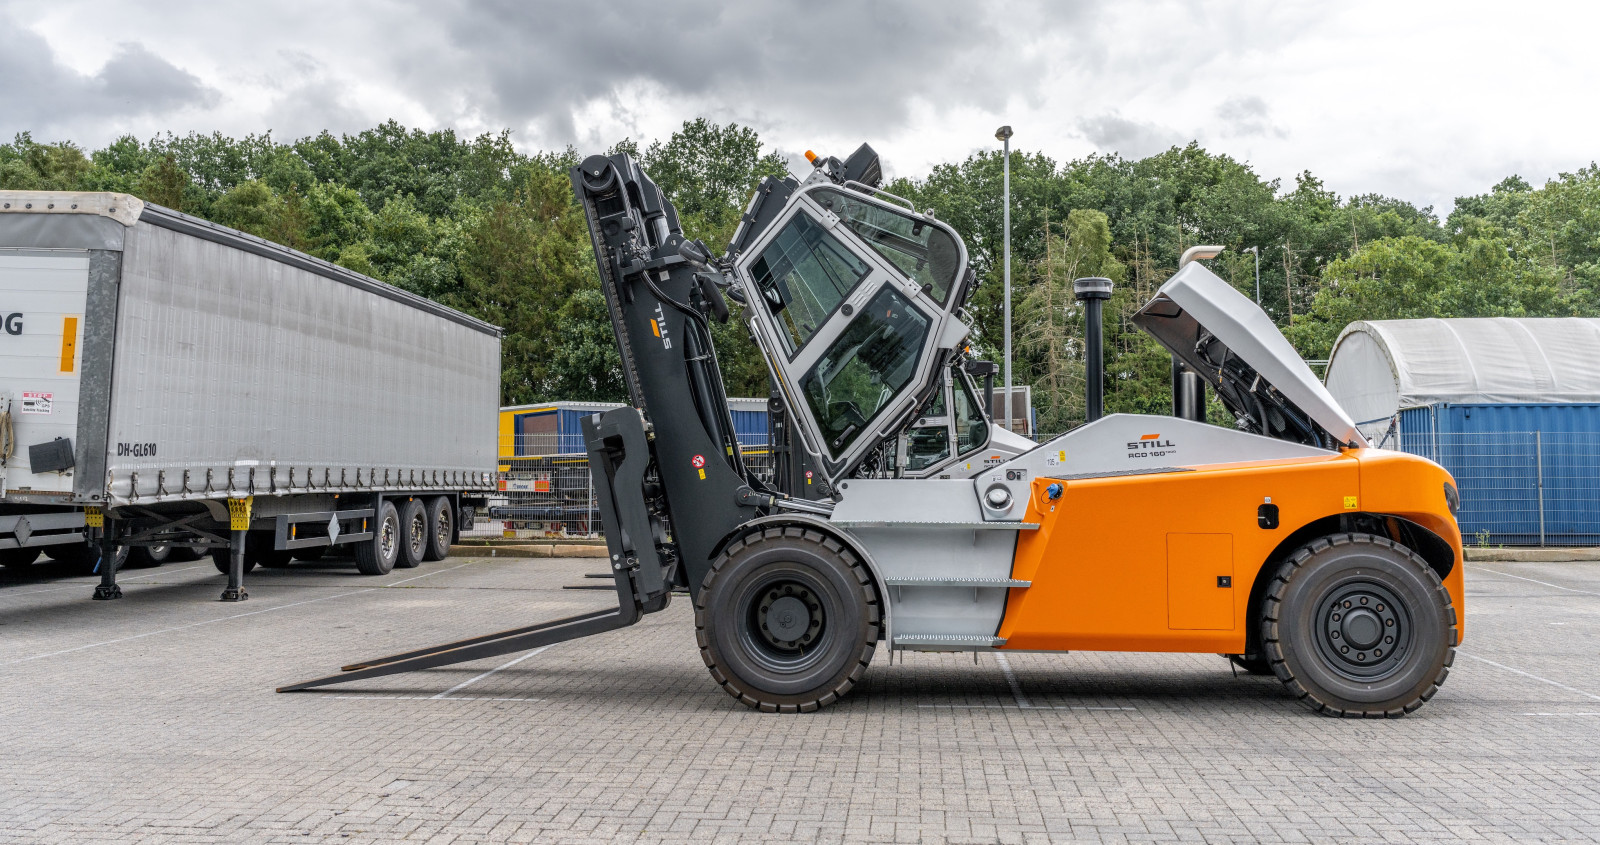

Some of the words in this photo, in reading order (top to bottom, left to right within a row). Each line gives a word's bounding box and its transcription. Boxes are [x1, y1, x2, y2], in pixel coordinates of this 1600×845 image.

[0, 312, 23, 336] G
[655, 303, 672, 349] STILL
[117, 442, 157, 457] DH-GL610
[1127, 440, 1175, 449] STILL
